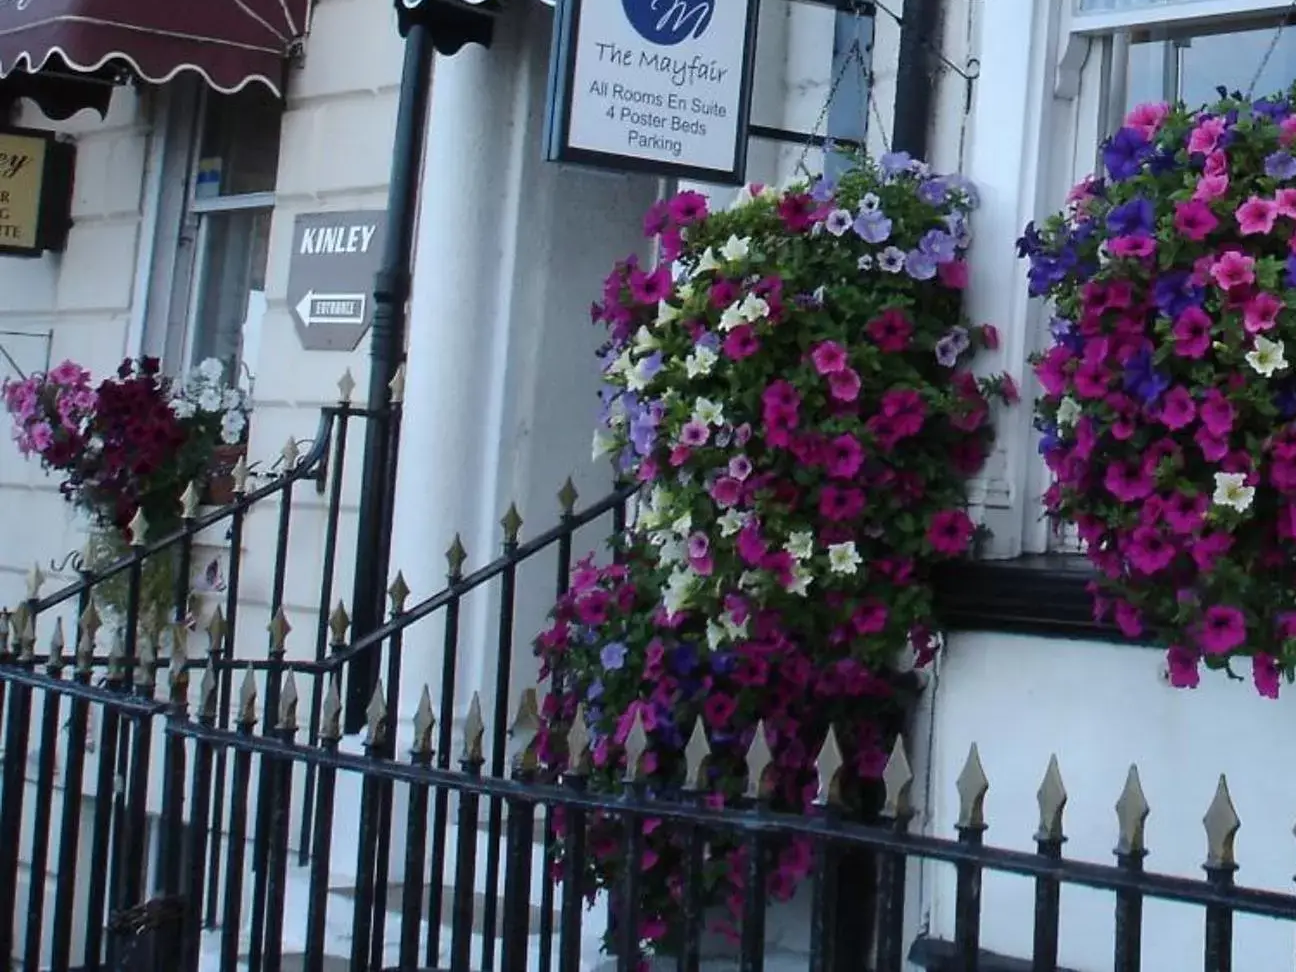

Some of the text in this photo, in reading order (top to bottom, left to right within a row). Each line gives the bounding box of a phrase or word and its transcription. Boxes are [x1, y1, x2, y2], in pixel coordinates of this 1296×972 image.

[595, 41, 728, 86] The Mayfair
[589, 79, 727, 118] All Rooms En Suite
[605, 105, 707, 136] 4 Poster Beds
[628, 129, 683, 156] Parking
[300, 225, 376, 254] KINLEY
